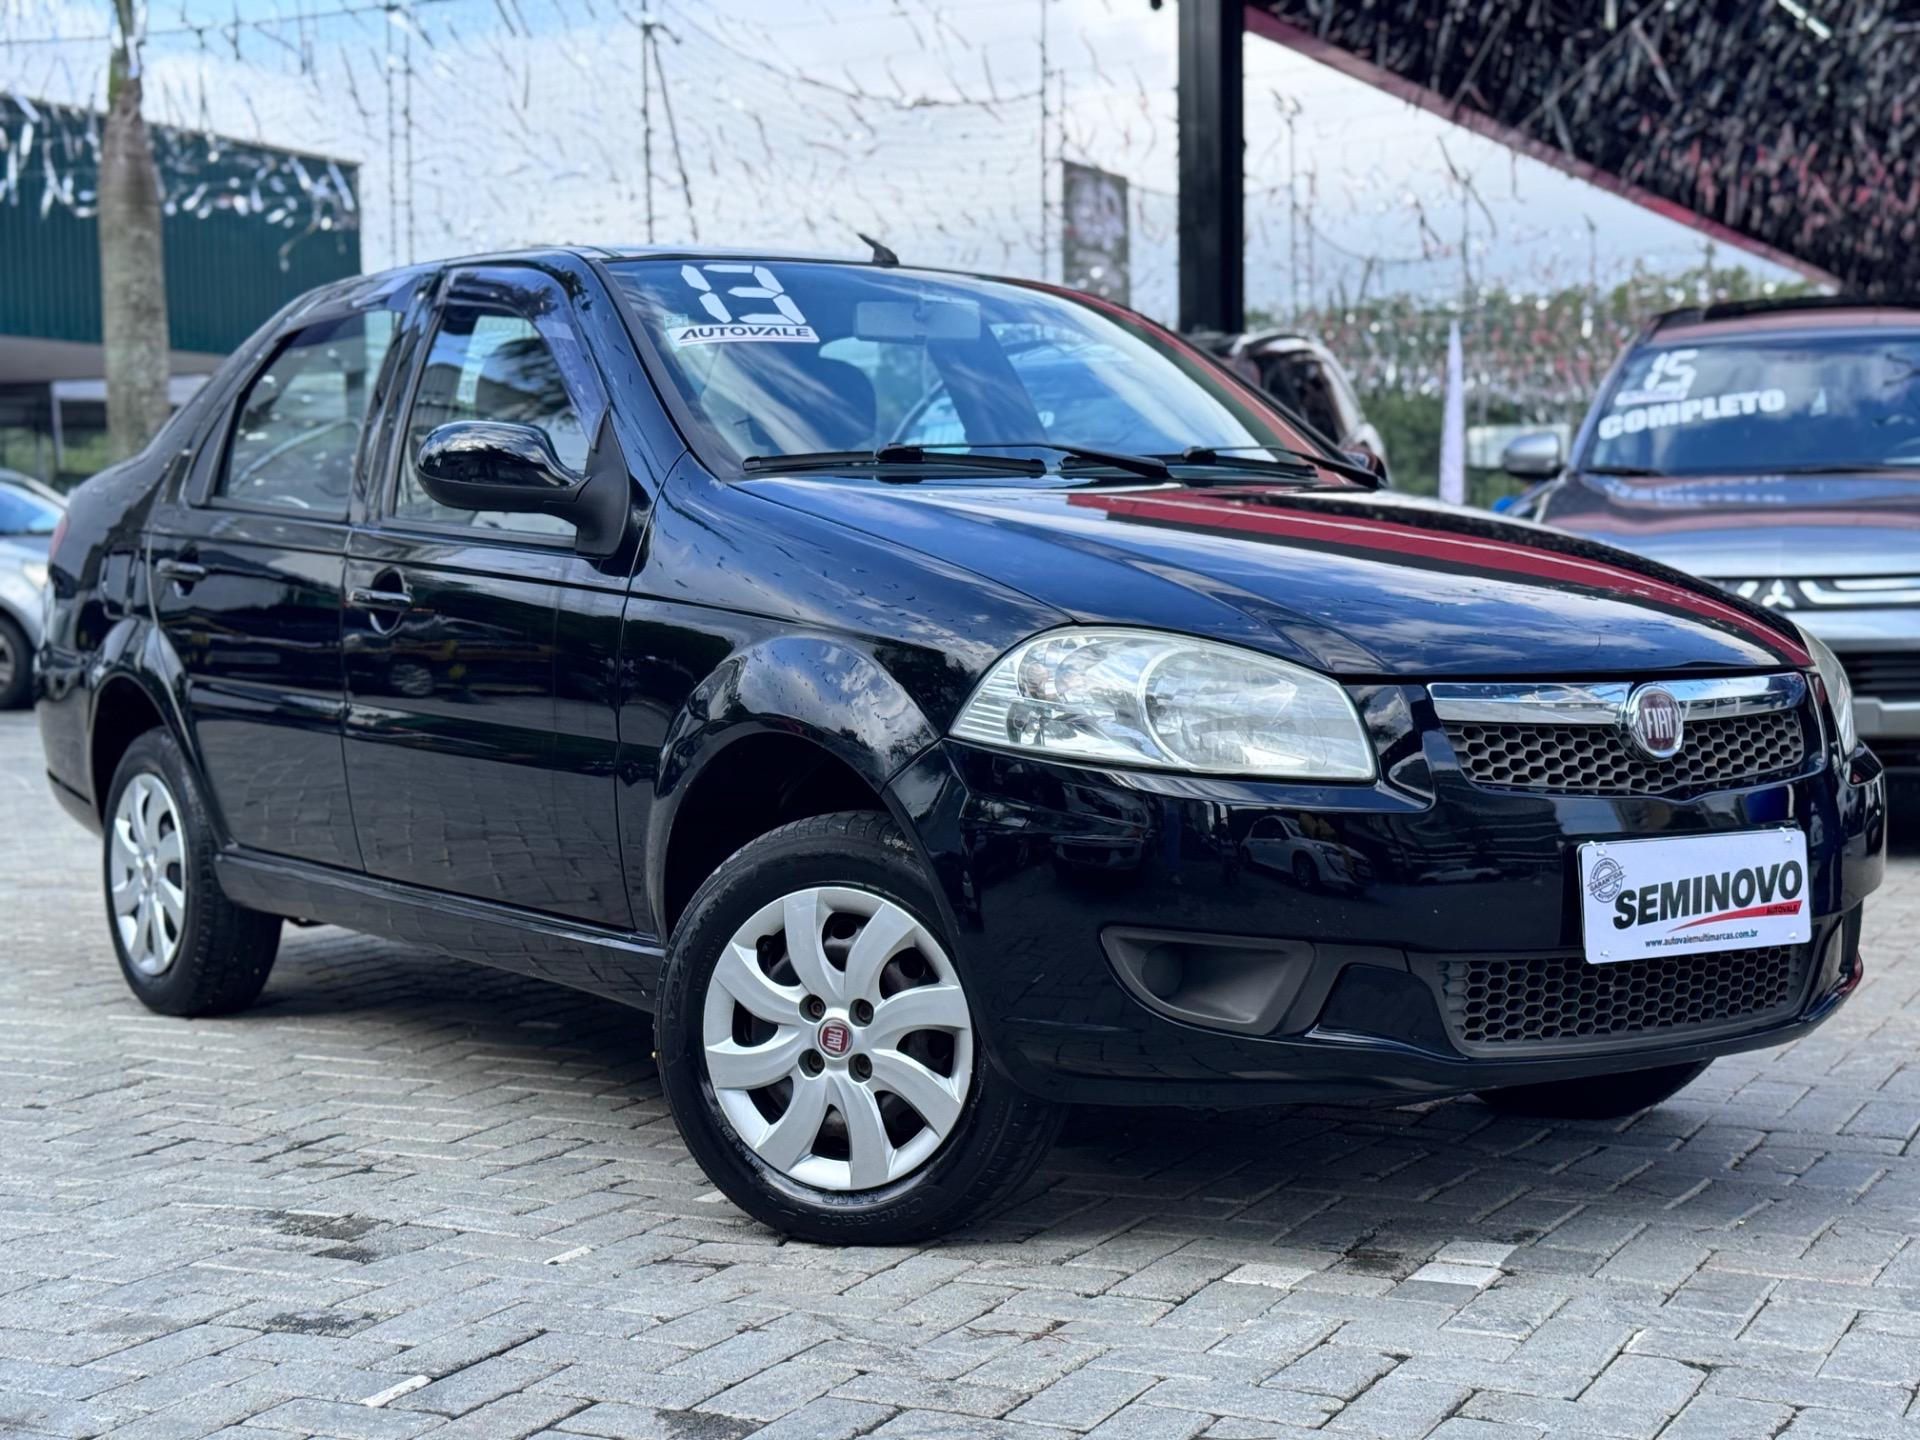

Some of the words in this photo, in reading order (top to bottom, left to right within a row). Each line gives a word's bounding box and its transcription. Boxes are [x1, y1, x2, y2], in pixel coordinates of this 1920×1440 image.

[681, 264, 807, 325] 13
[679, 327, 811, 339] AUTOVALE
[1643, 349, 1699, 391] 15
[1598, 388, 1786, 440] COMPLETO
[1643, 706, 1674, 740] FIAT
[1612, 860, 1803, 930] SEMINOVO
[826, 1027, 844, 1051] FIAT
